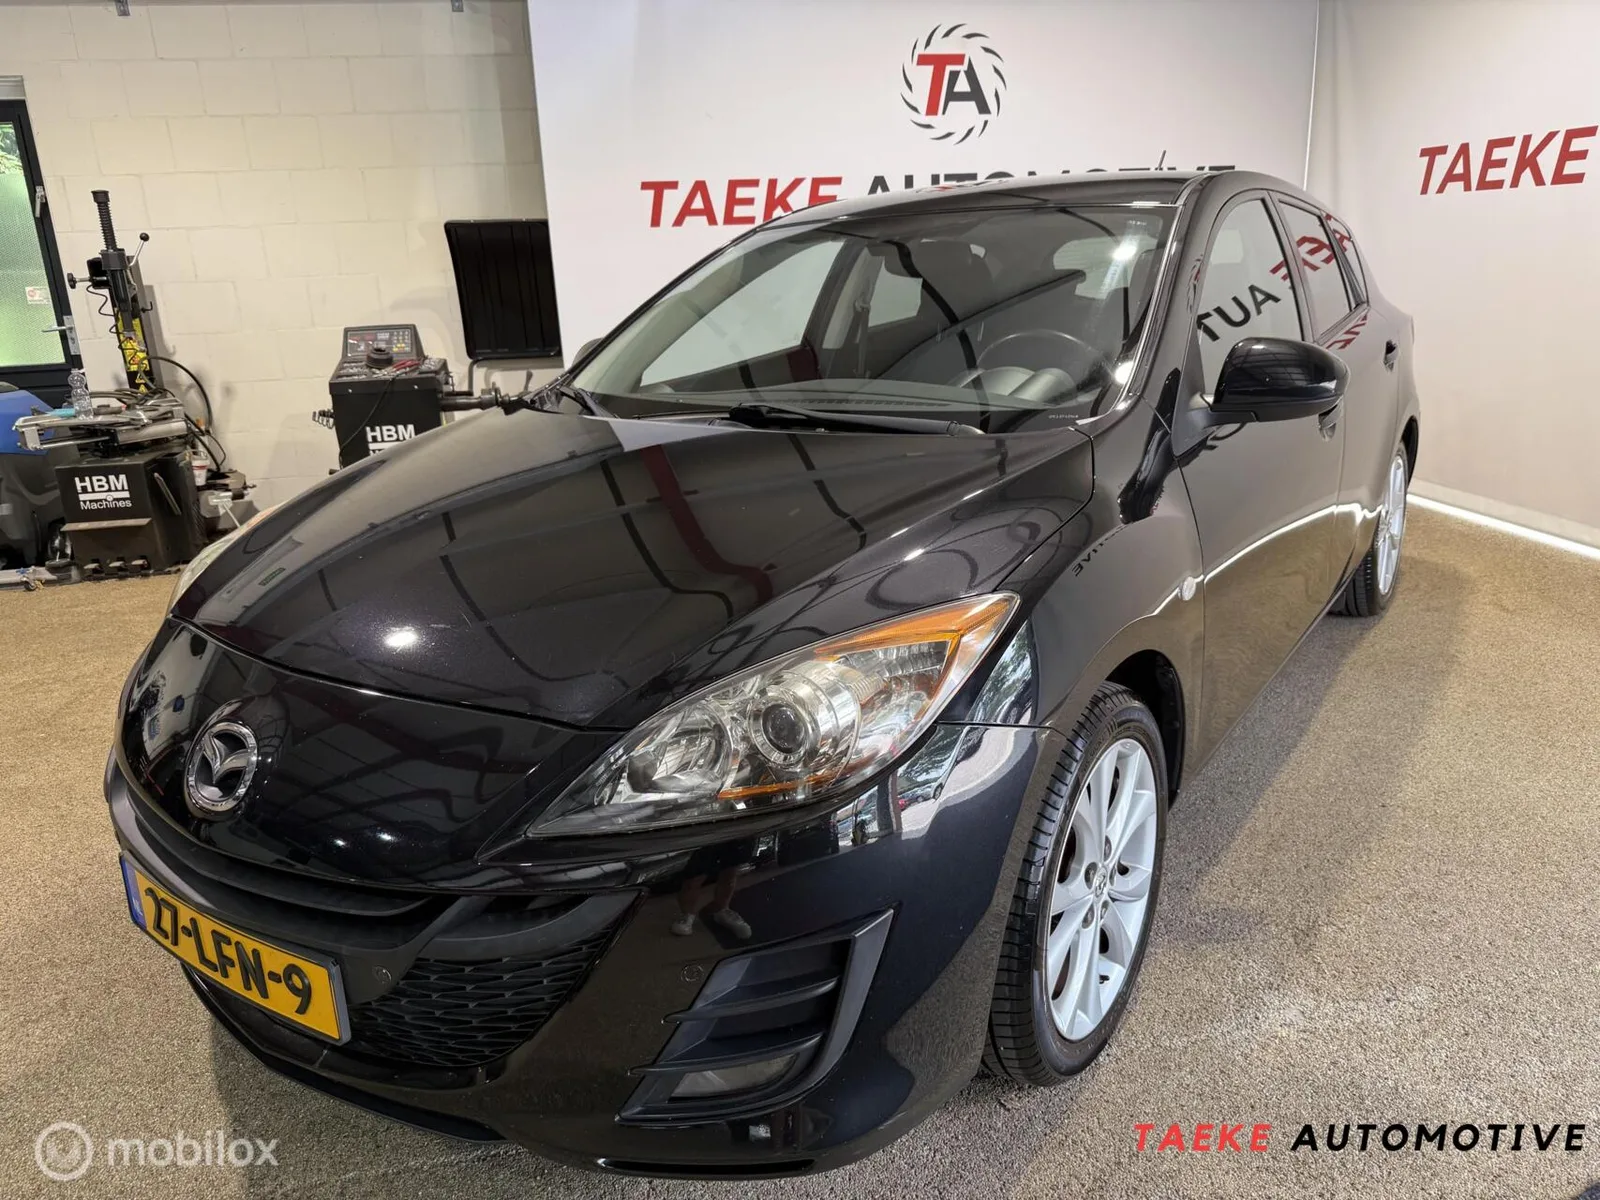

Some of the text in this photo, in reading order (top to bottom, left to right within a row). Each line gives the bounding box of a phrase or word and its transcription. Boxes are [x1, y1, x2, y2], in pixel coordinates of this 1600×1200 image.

[916, 53, 992, 116] TA
[1419, 125, 1599, 195] TAEKE
[365, 424, 416, 442] HBM
[74, 474, 129, 493] HBM
[79, 499, 132, 510] Machines
[144, 886, 312, 1015] 27-LFN-9
